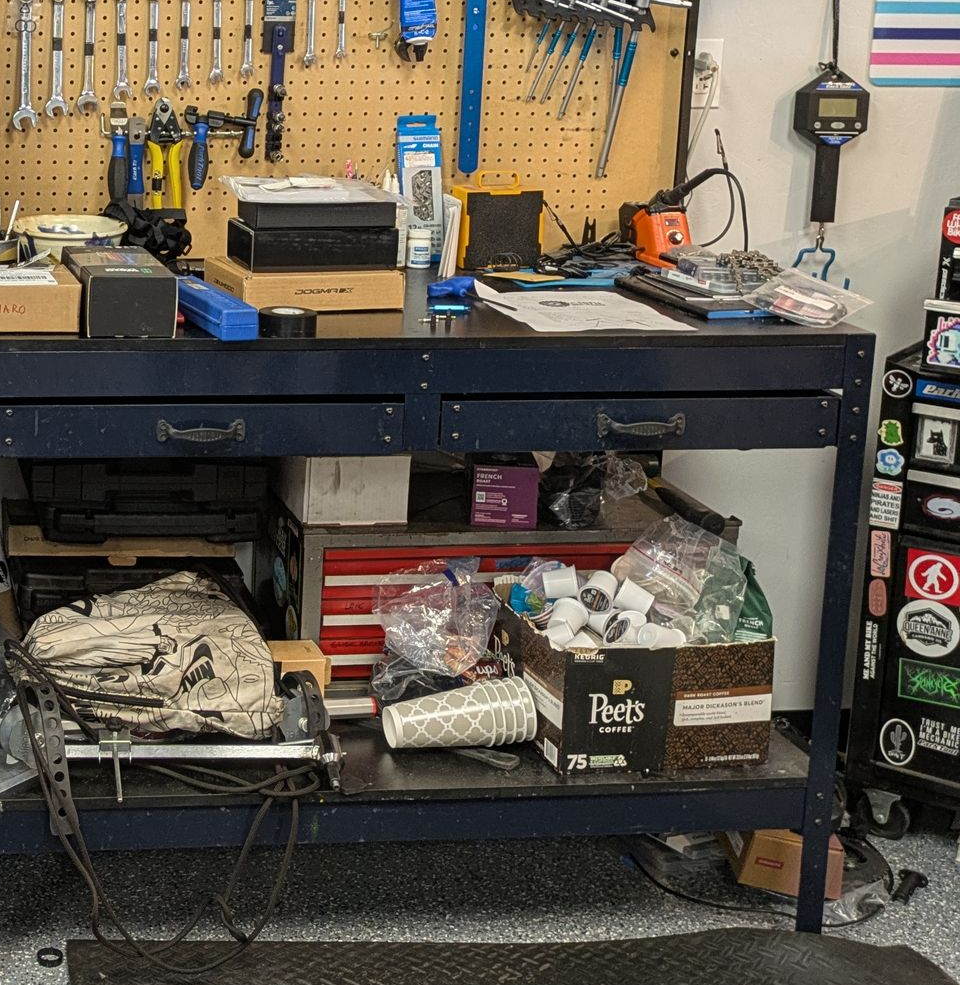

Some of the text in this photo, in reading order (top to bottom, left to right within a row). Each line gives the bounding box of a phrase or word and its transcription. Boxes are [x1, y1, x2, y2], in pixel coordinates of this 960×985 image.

[294, 286, 339, 295] DOGMA
[871, 491, 889, 500] NINJAS
[871, 499, 900, 509] PIRATES
[870, 506, 899, 516] AND LASERS
[738, 618, 764, 627] FRENCH
[904, 620, 929, 634] QUEEN
[928, 624, 953, 640] ANNE
[865, 639, 872, 651] MY
[863, 651, 871, 668] AND
[475, 664, 499, 679] ups
[869, 655, 877, 680] AGAINST
[862, 668, 870, 680] ME
[588, 693, 646, 725] Peet's
[682, 699, 764, 711] MAJOR DICKASON'S BLEND
[598, 725, 633, 734] COFFEE
[921, 717, 960, 736] TRUST ME
[918, 731, 960, 749] MECHANIC
[942, 730, 960, 743] BIKE
[566, 753, 588, 770] 75
